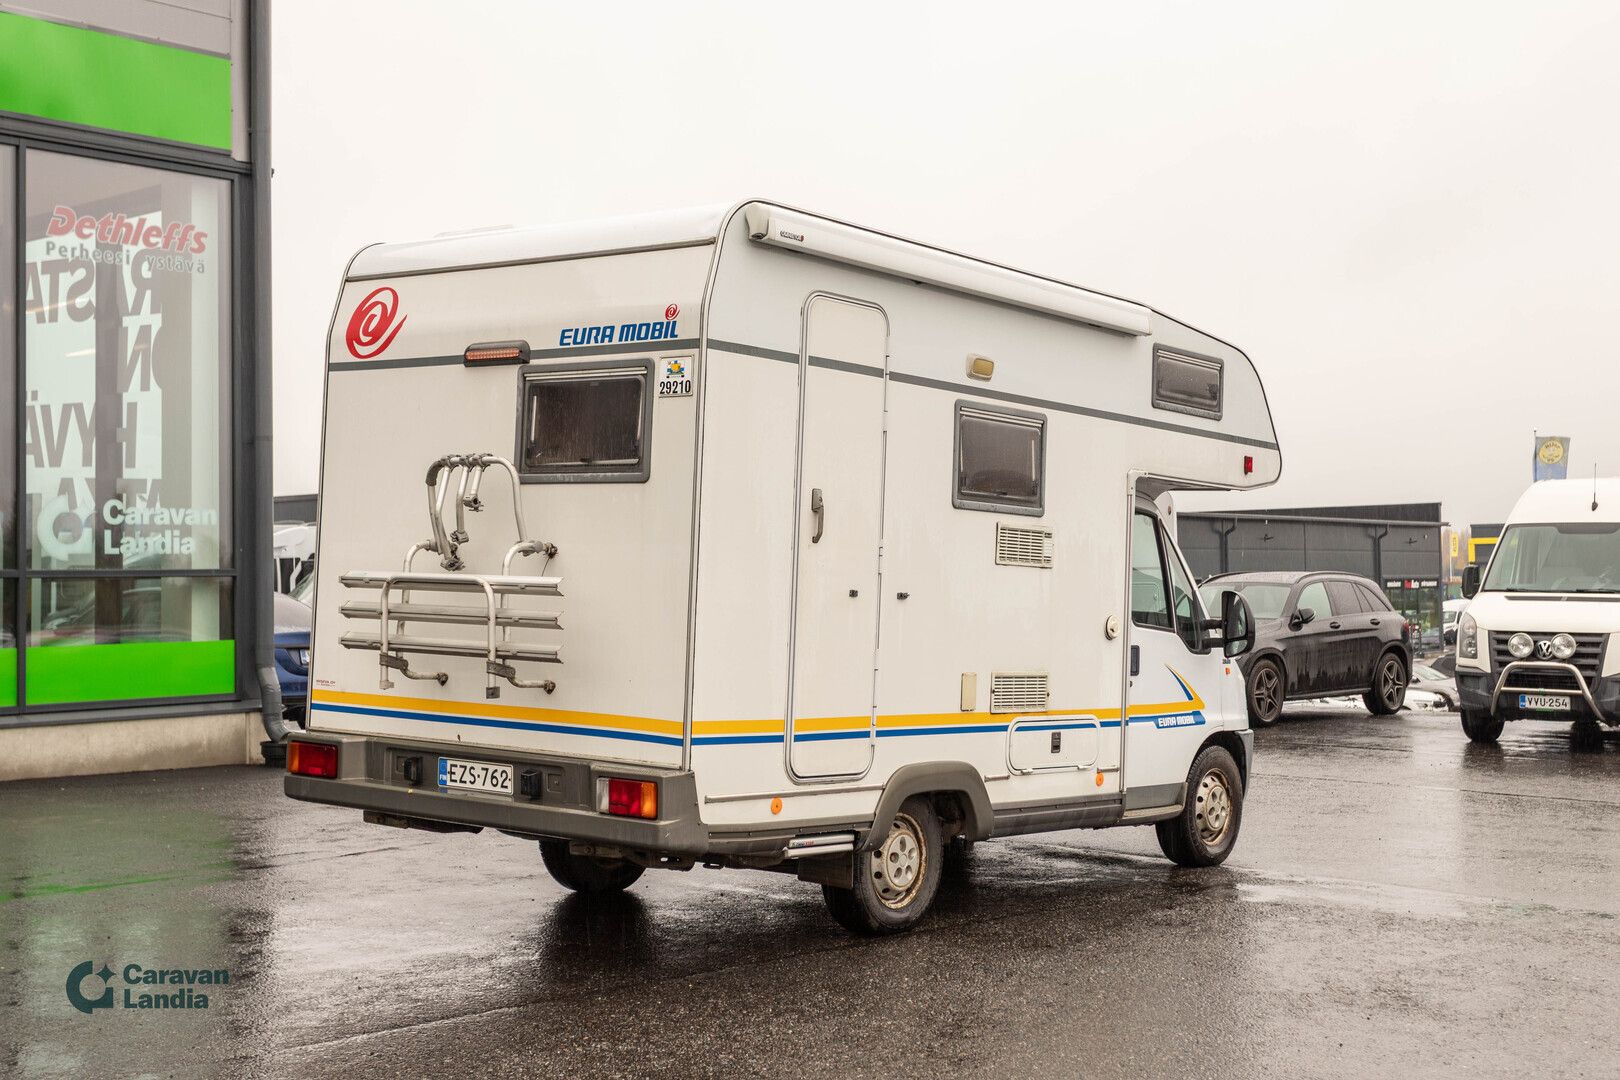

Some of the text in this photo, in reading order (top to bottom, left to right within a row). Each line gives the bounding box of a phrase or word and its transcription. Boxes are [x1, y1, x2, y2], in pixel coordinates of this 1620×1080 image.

[47, 205, 208, 255] Dethleffs
[46, 241, 206, 275] Perheesi ystävä
[559, 320, 679, 346] EURA MOBIL
[659, 379, 691, 395] 29210
[102, 498, 217, 526] Caravan
[103, 529, 195, 555] Landia
[449, 763, 509, 789] EZS-762
